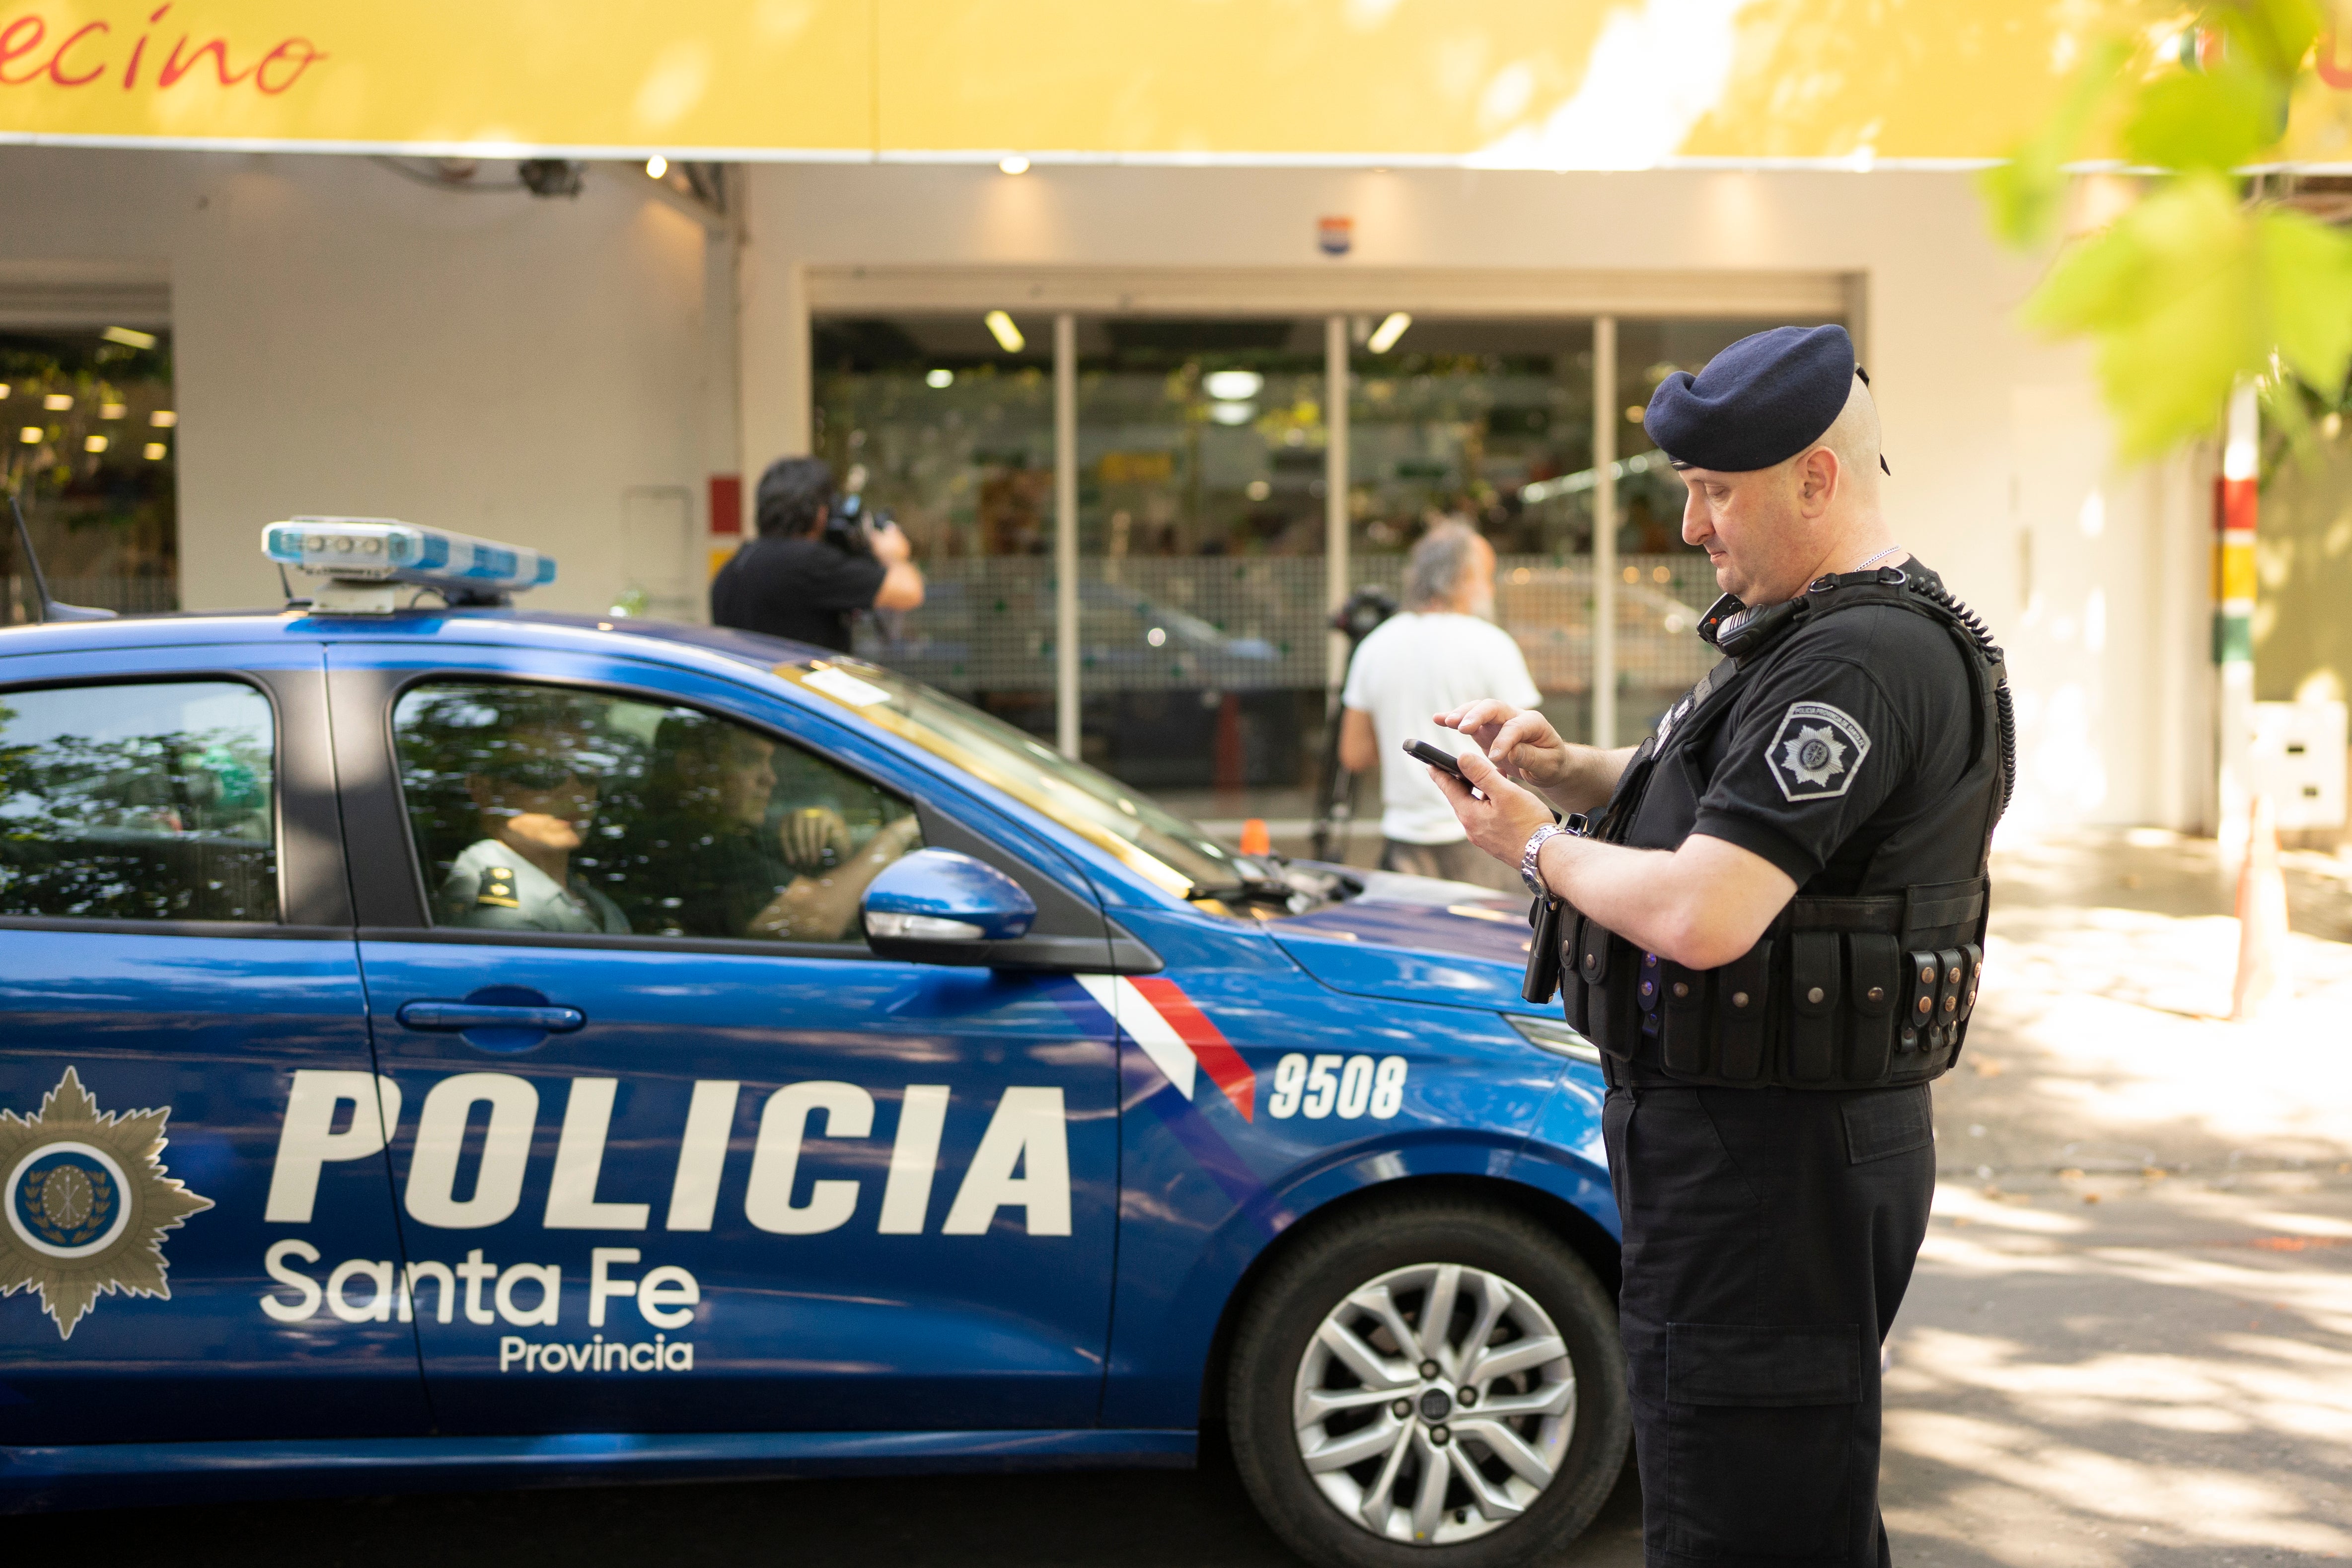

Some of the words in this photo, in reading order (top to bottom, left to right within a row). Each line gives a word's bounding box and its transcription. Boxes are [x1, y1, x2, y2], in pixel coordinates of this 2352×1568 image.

[1268, 1052, 1408, 1119] 9508
[264, 1069, 1072, 1236] POLICIA
[259, 1239, 561, 1327] Santa
[588, 1247, 700, 1330] Fe
[500, 1334, 694, 1373] Provincia
